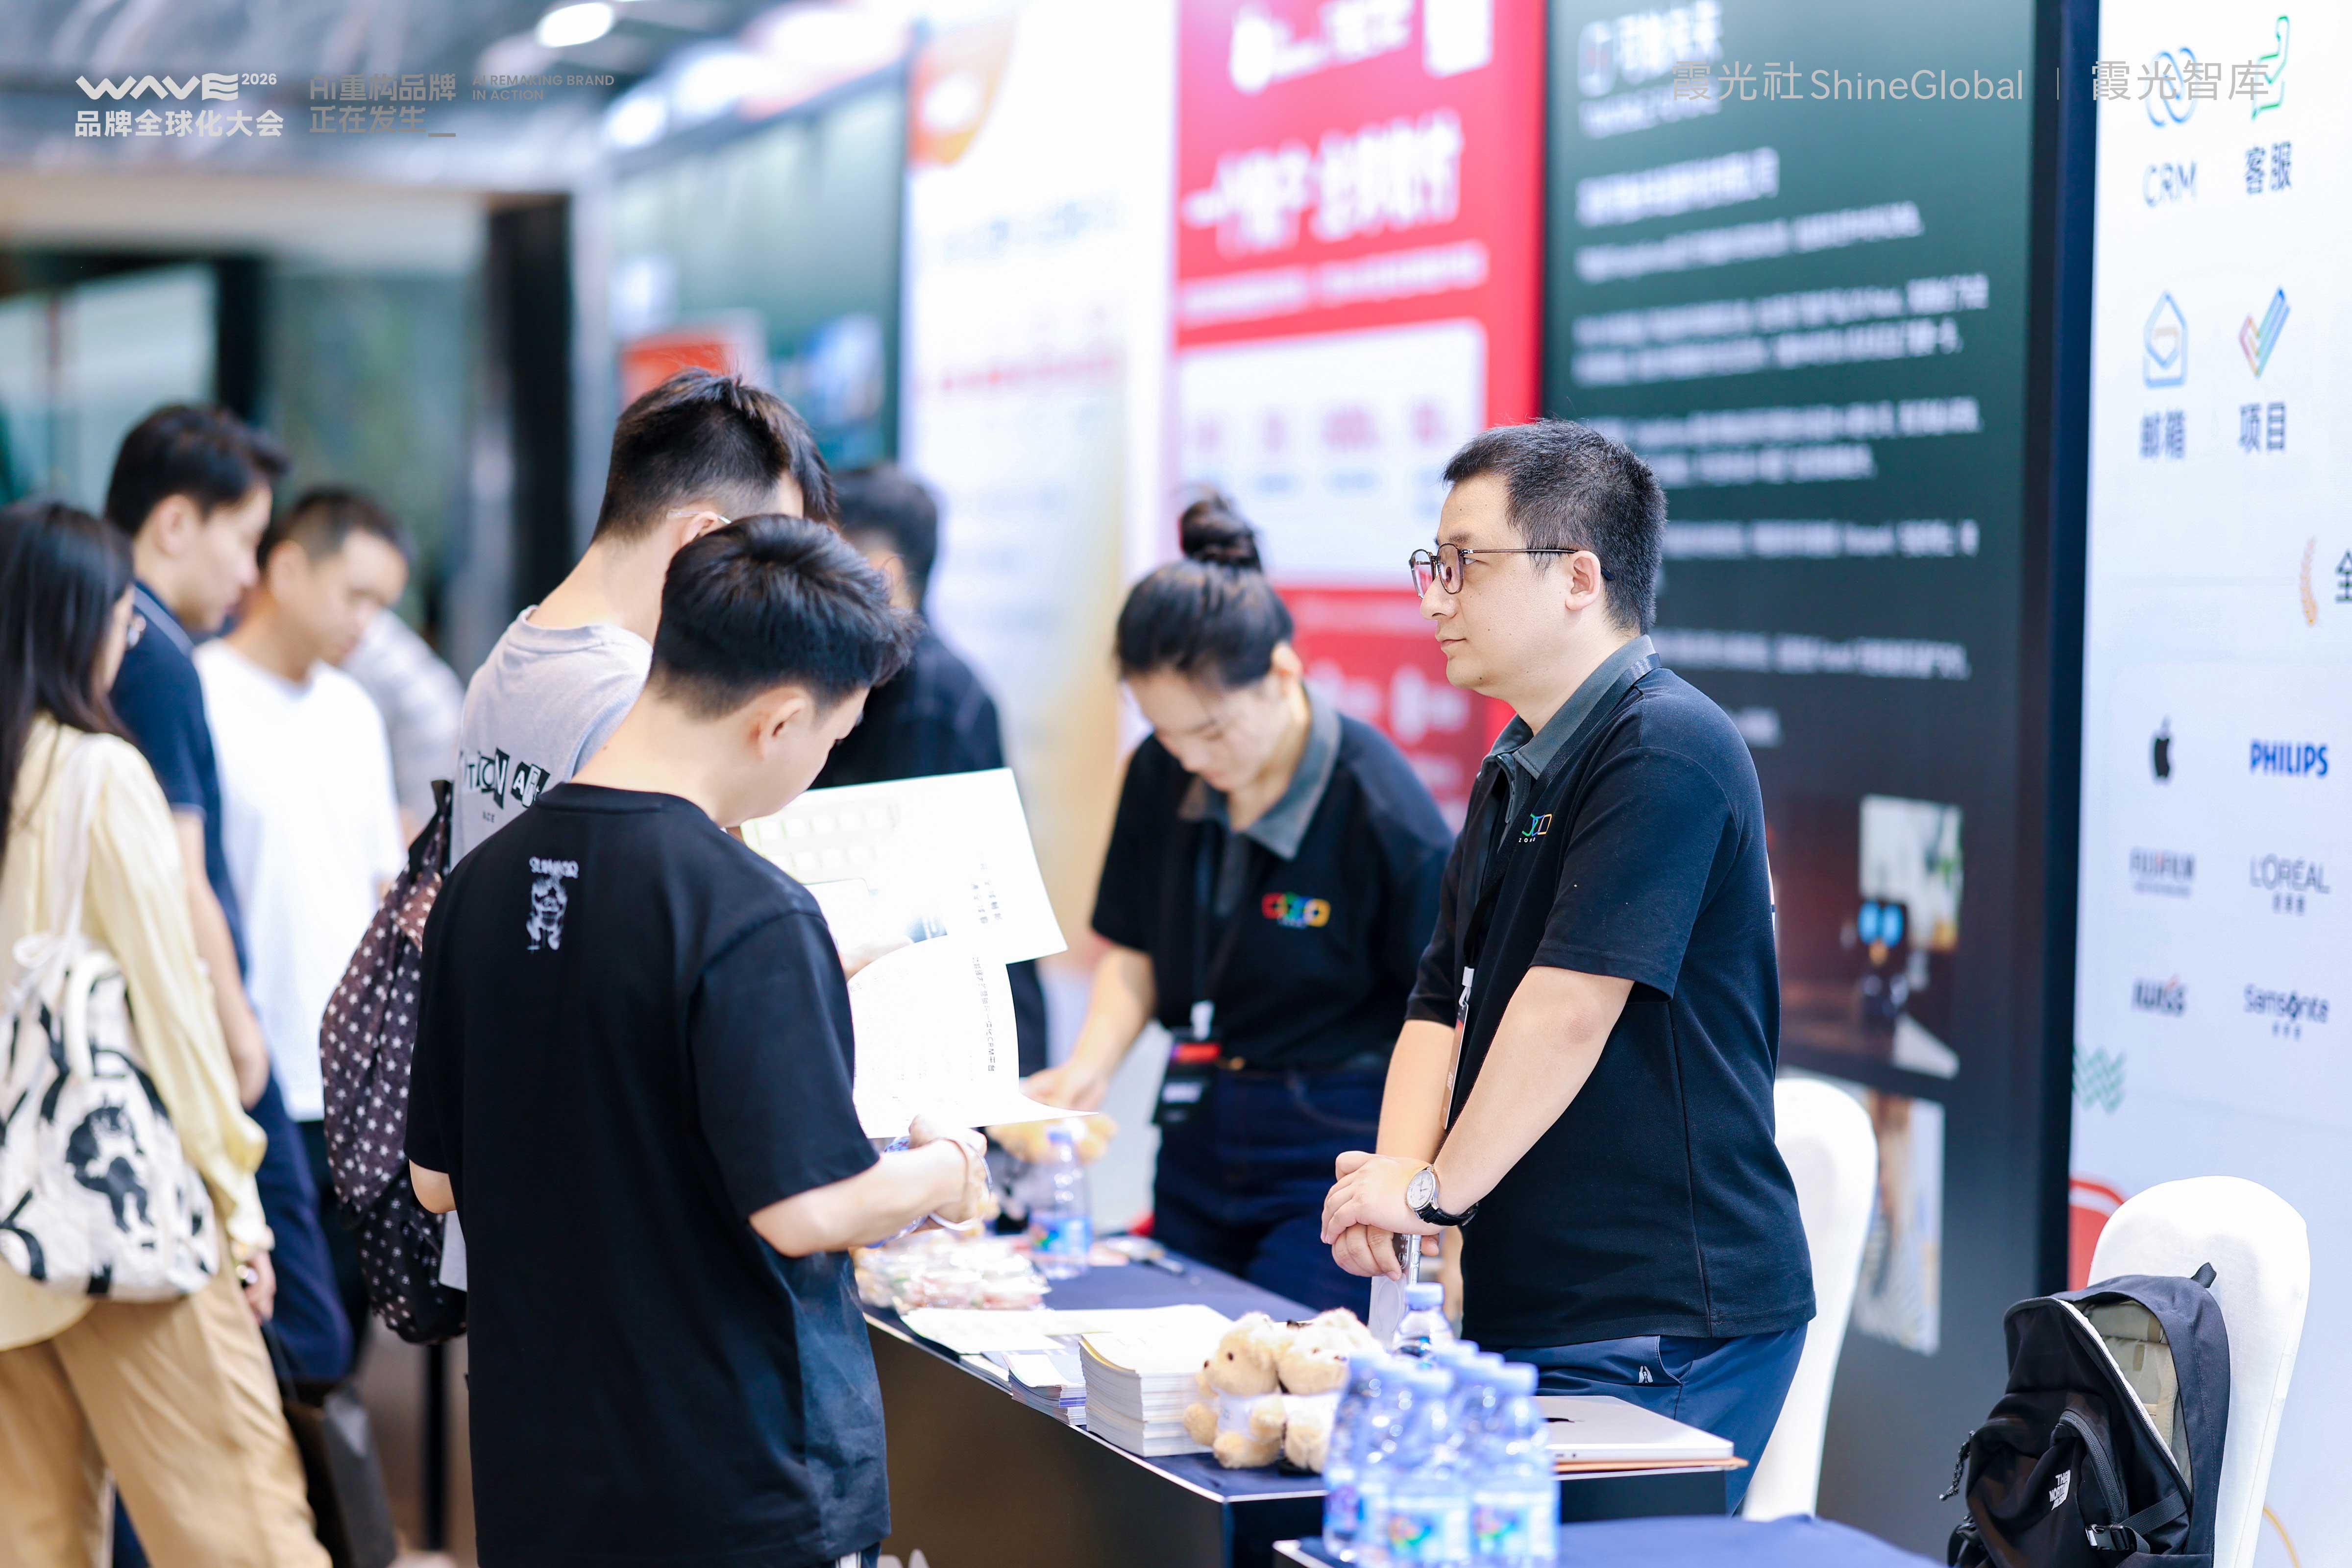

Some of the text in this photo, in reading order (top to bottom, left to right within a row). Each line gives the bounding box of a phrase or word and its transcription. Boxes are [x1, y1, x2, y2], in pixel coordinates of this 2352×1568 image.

[2143, 161, 2197, 207] CRM
[2243, 141, 2292, 194] 客服
[2238, 402, 2285, 453] 项目
[2250, 739, 2329, 777] PHILIPS
